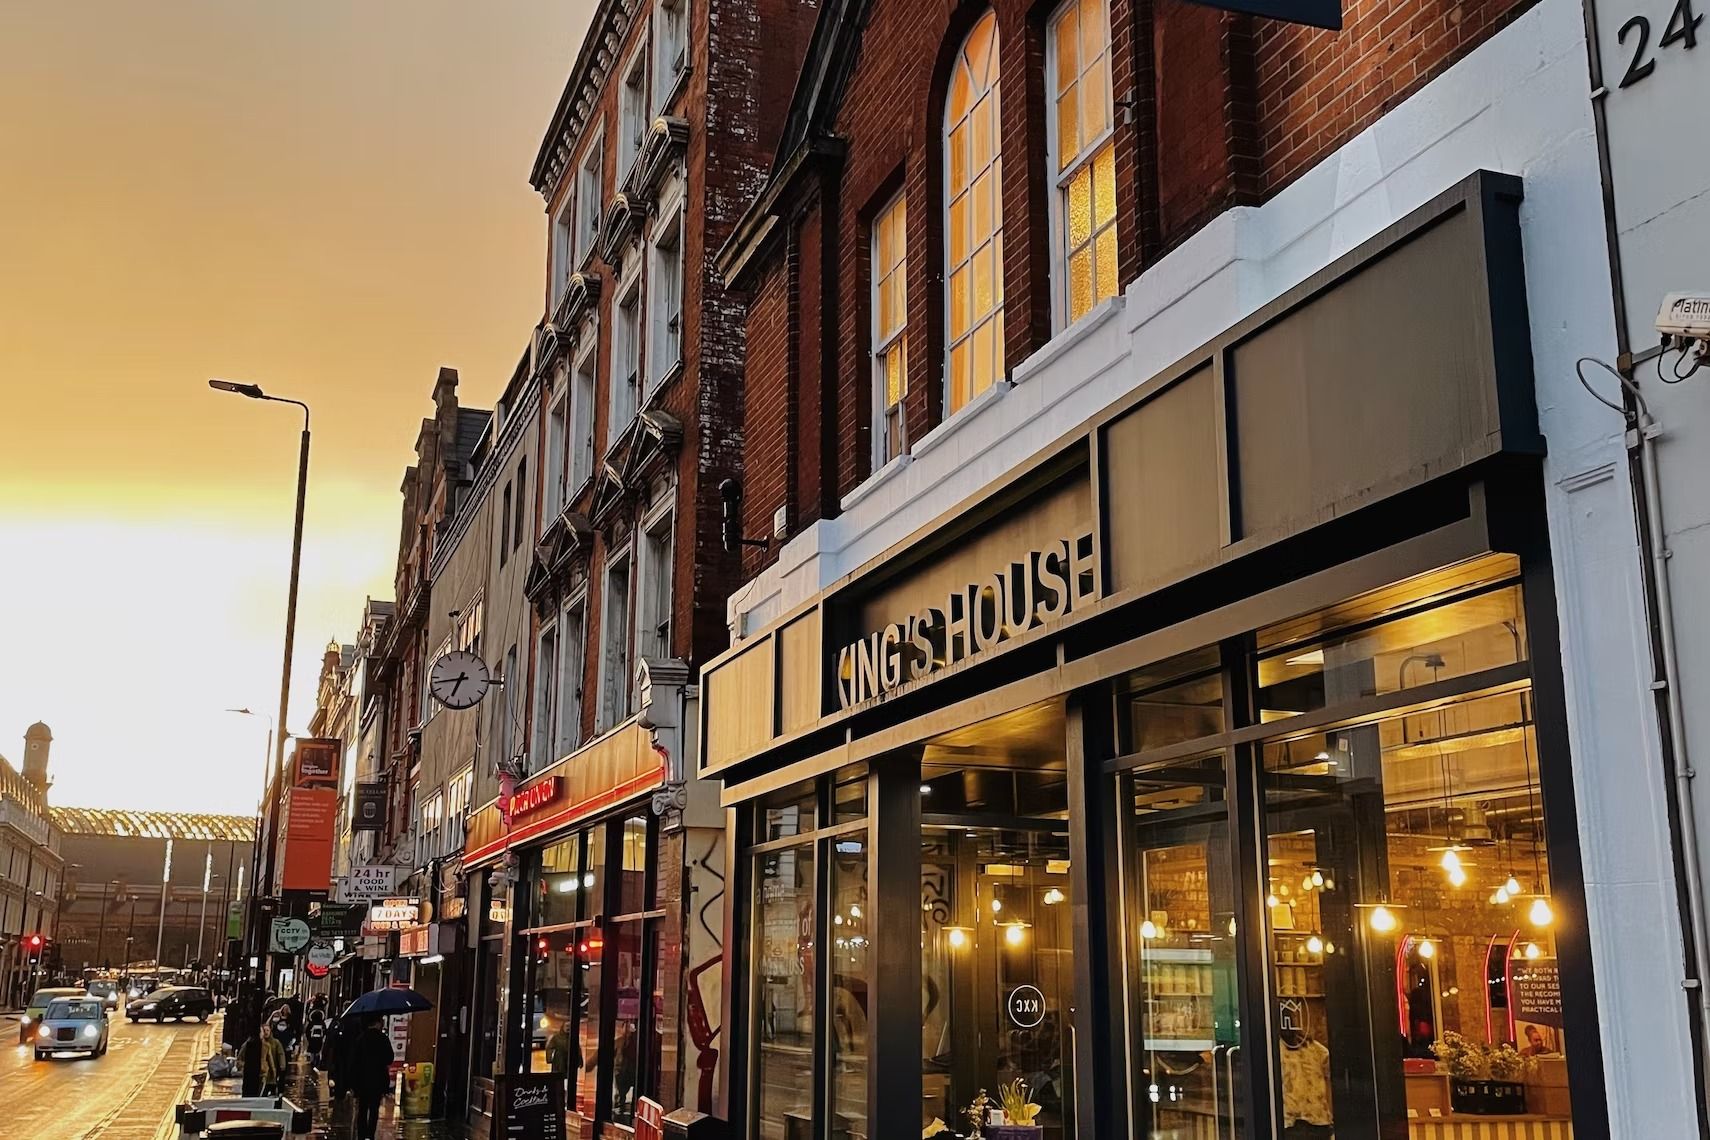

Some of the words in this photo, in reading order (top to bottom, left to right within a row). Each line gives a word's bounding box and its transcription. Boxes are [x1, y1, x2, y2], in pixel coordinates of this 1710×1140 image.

[1617, 0, 1706, 89] 24
[1671, 298, 1710, 313] Platin
[834, 607, 938, 709] KING'S
[945, 531, 1102, 667] HOUSE
[509, 790, 530, 817] PZZA
[530, 776, 555, 808] UNON
[354, 869, 370, 878] 24
[376, 869, 390, 878] hr
